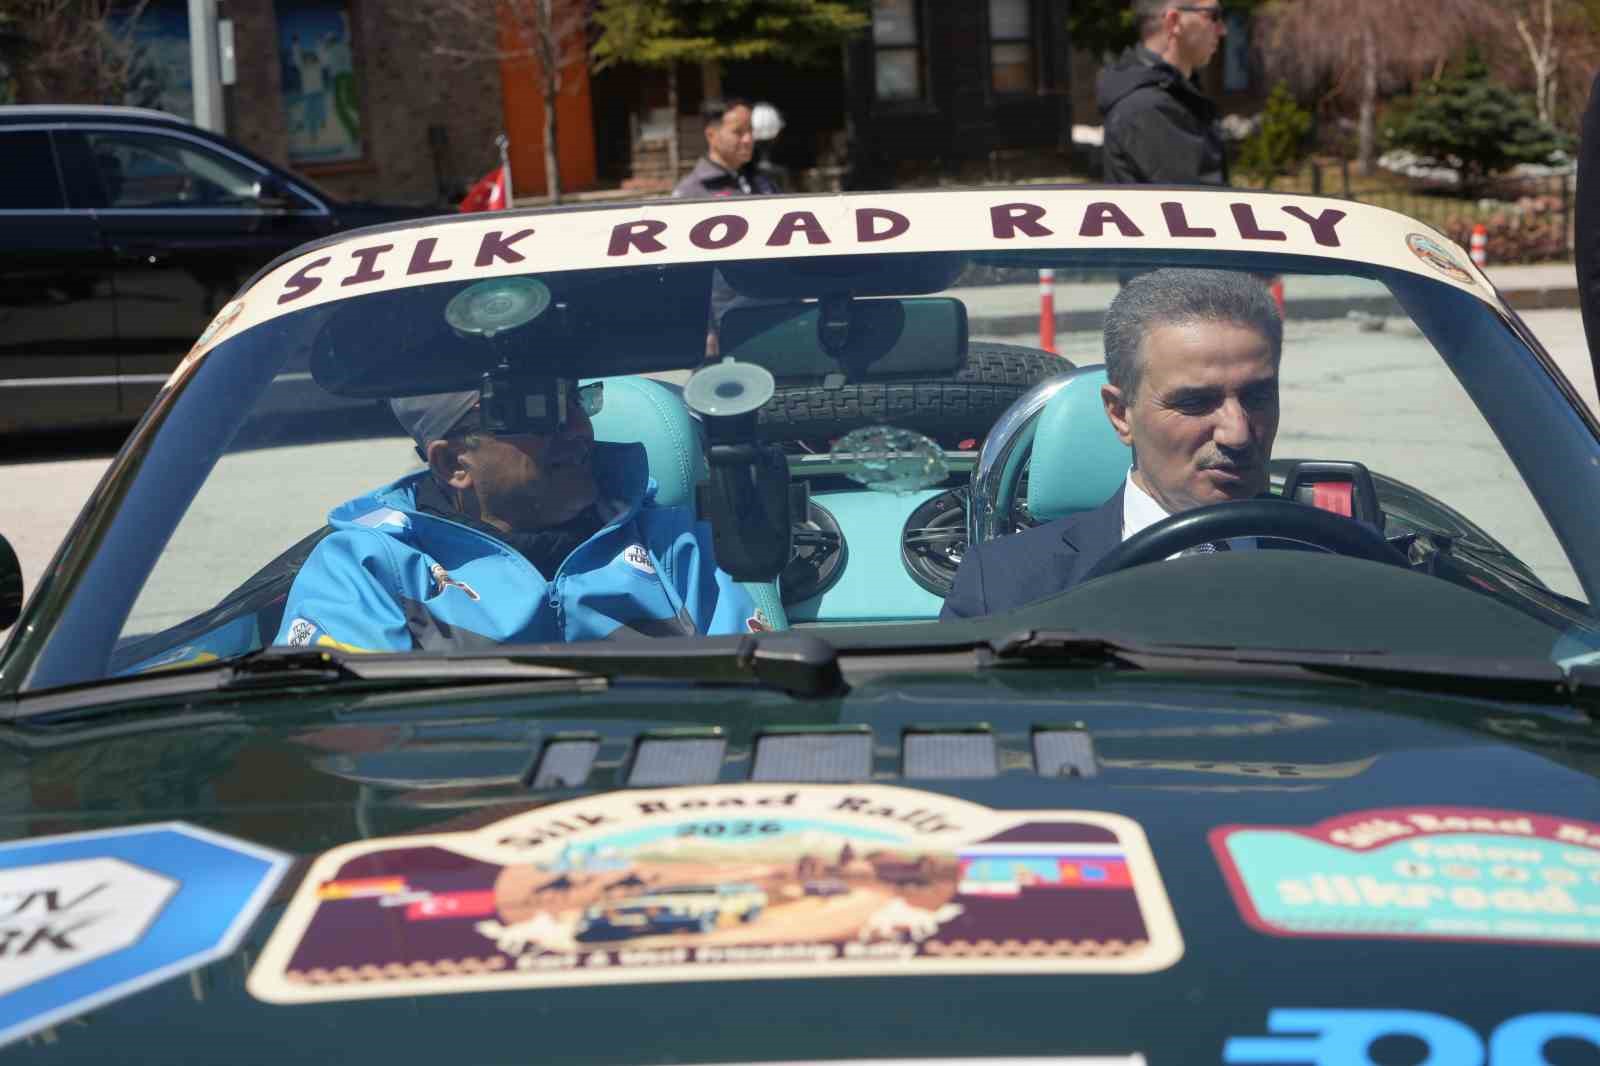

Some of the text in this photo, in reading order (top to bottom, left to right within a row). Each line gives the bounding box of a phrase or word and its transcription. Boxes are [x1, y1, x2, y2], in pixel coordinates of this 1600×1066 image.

[276, 202, 1347, 305] SILK ROAD RALLY
[637, 793, 798, 815] Road
[833, 796, 963, 834] Rally
[674, 820, 783, 838] 2026
